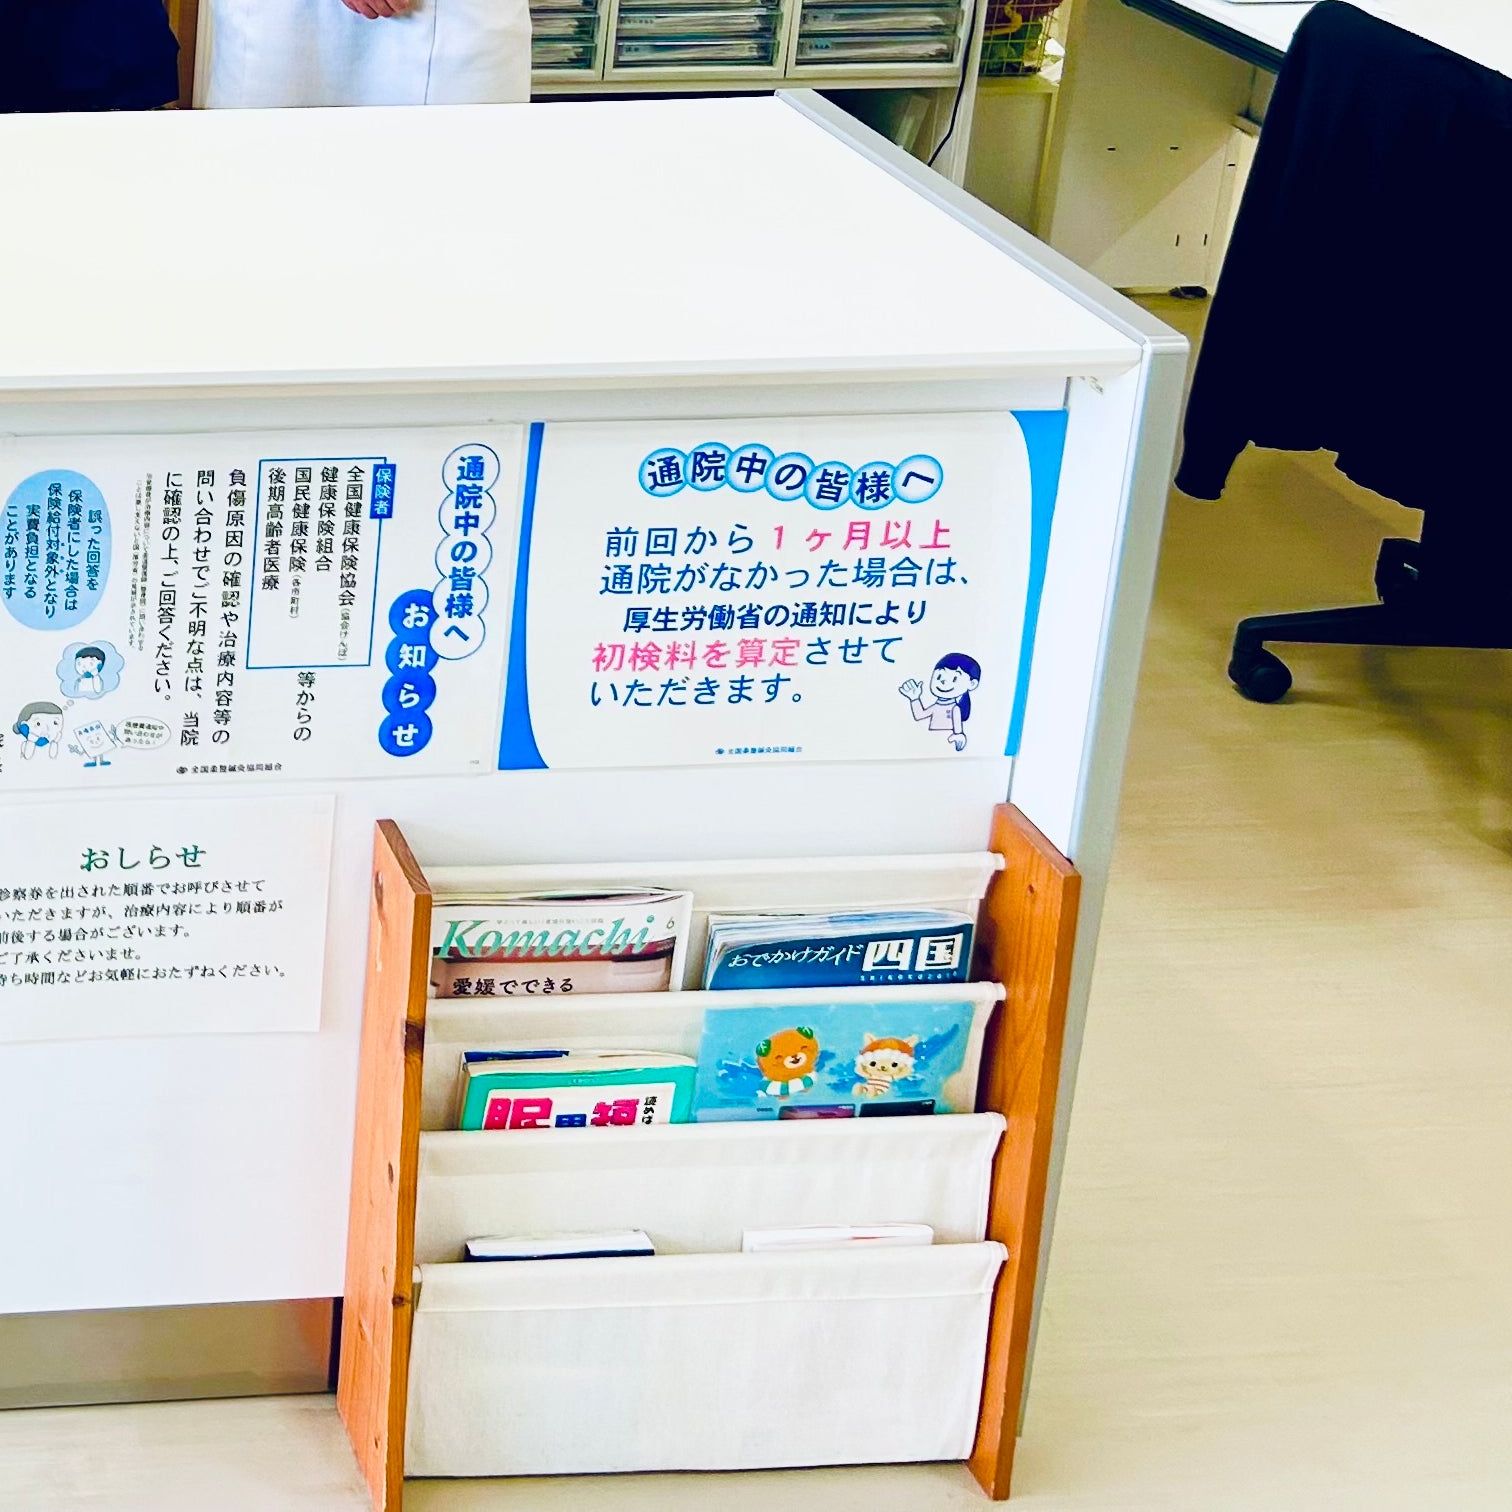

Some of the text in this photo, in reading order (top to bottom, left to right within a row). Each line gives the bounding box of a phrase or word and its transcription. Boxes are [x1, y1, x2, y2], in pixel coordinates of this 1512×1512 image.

[373, 467, 393, 516] 保険者
[646, 450, 935, 503] 通院中の皆様へ
[3, 505, 19, 599] ことがあります
[24, 504, 41, 599] 実費負担となる
[43, 482, 62, 619] 保険給付対象外となり
[64, 489, 82, 611] 保険者にした場合は
[85, 509, 102, 591] 誤った回答を
[261, 466, 286, 591] 後期高齢者医療
[314, 466, 339, 572] 健康保険組合
[444, 455, 484, 642] 通院中の皆様へ
[212, 468, 246, 745] 負傷原因の確認や治療内容等の
[599, 556, 971, 596] 通院がなかった場合は、
[623, 600, 928, 634] 厚生労働省の通知により
[392, 603, 430, 747] お知らせ
[591, 636, 904, 673] 初検料を算定させて
[293, 671, 316, 742] 等からの
[590, 674, 804, 708] いただきます。
[80, 844, 207, 872] おしらせ
[437, 915, 656, 959] Komachi
[728, 932, 964, 972] おでかけガイド 四国
[452, 977, 574, 995] 愛媛でできる
